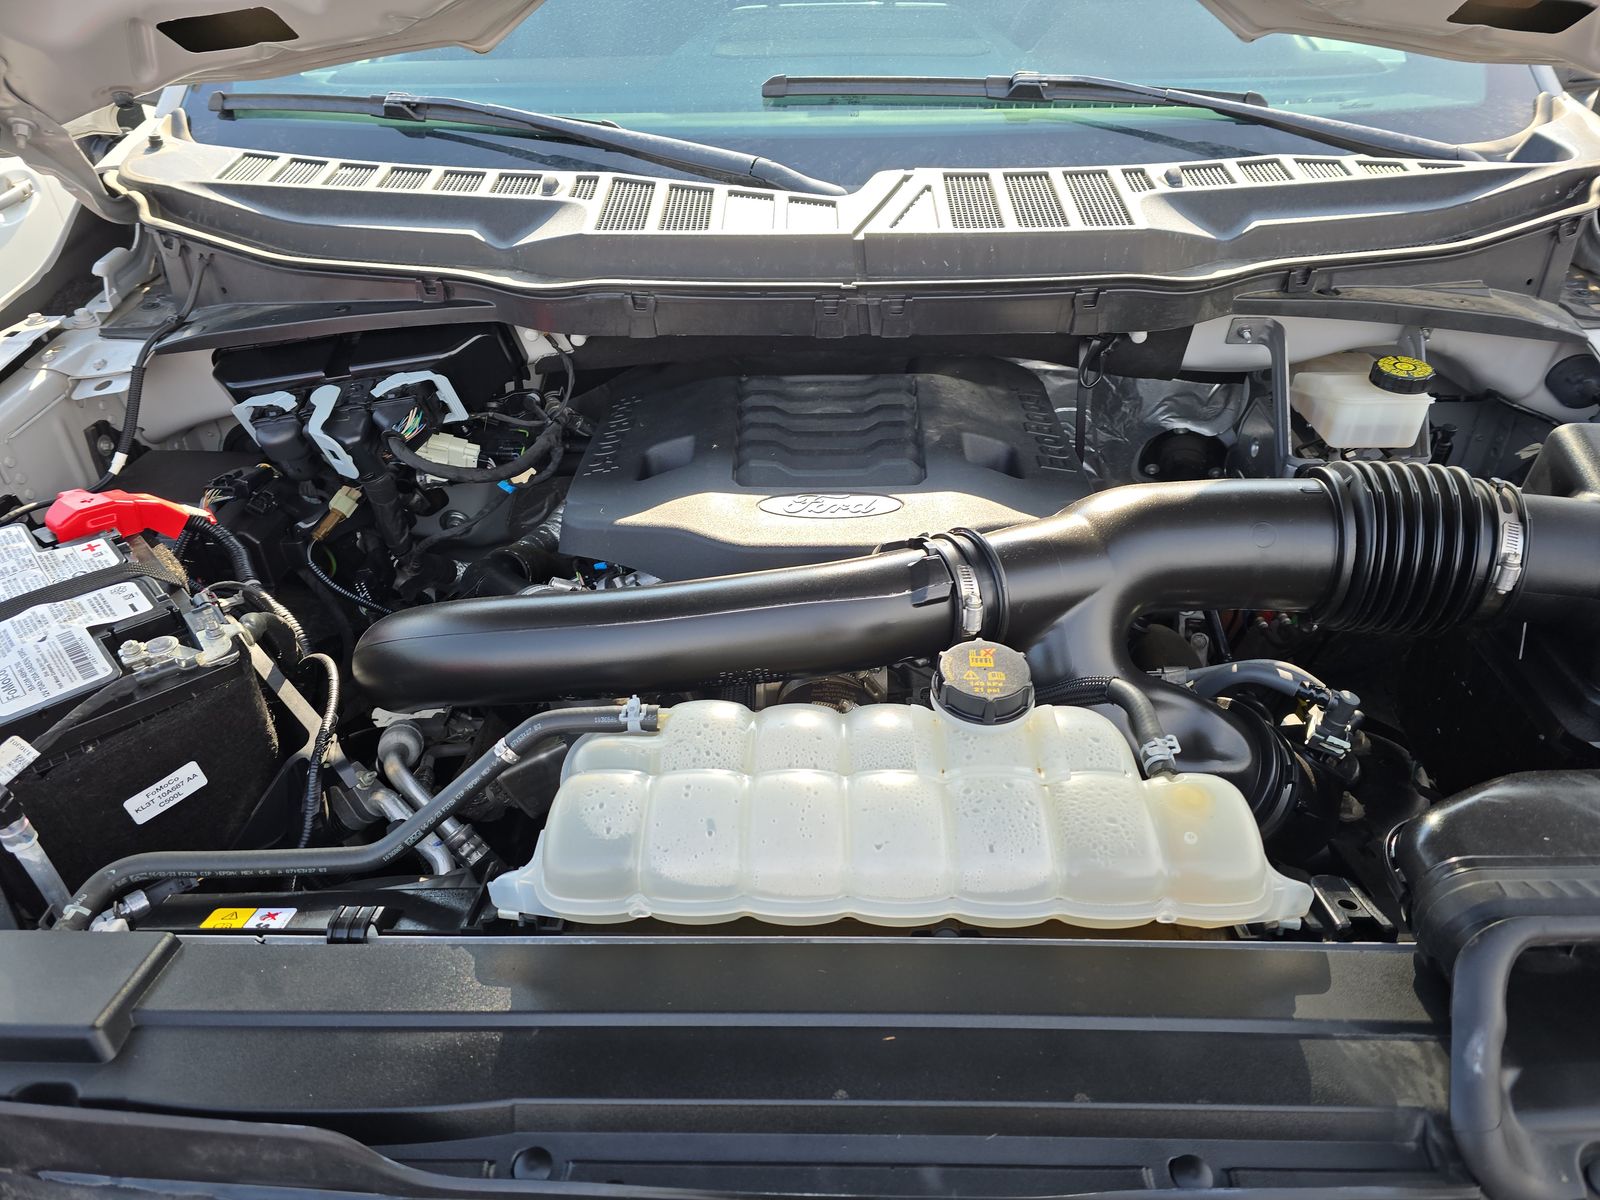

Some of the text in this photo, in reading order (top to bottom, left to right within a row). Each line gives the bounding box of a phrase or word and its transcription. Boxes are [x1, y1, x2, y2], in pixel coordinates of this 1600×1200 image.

[783, 494, 878, 515] Ford
[135, 799, 156, 814] KL3T
[187, 773, 199, 783] AA
[145, 776, 180, 799] FoMoCo
[158, 791, 184, 808] C500L
